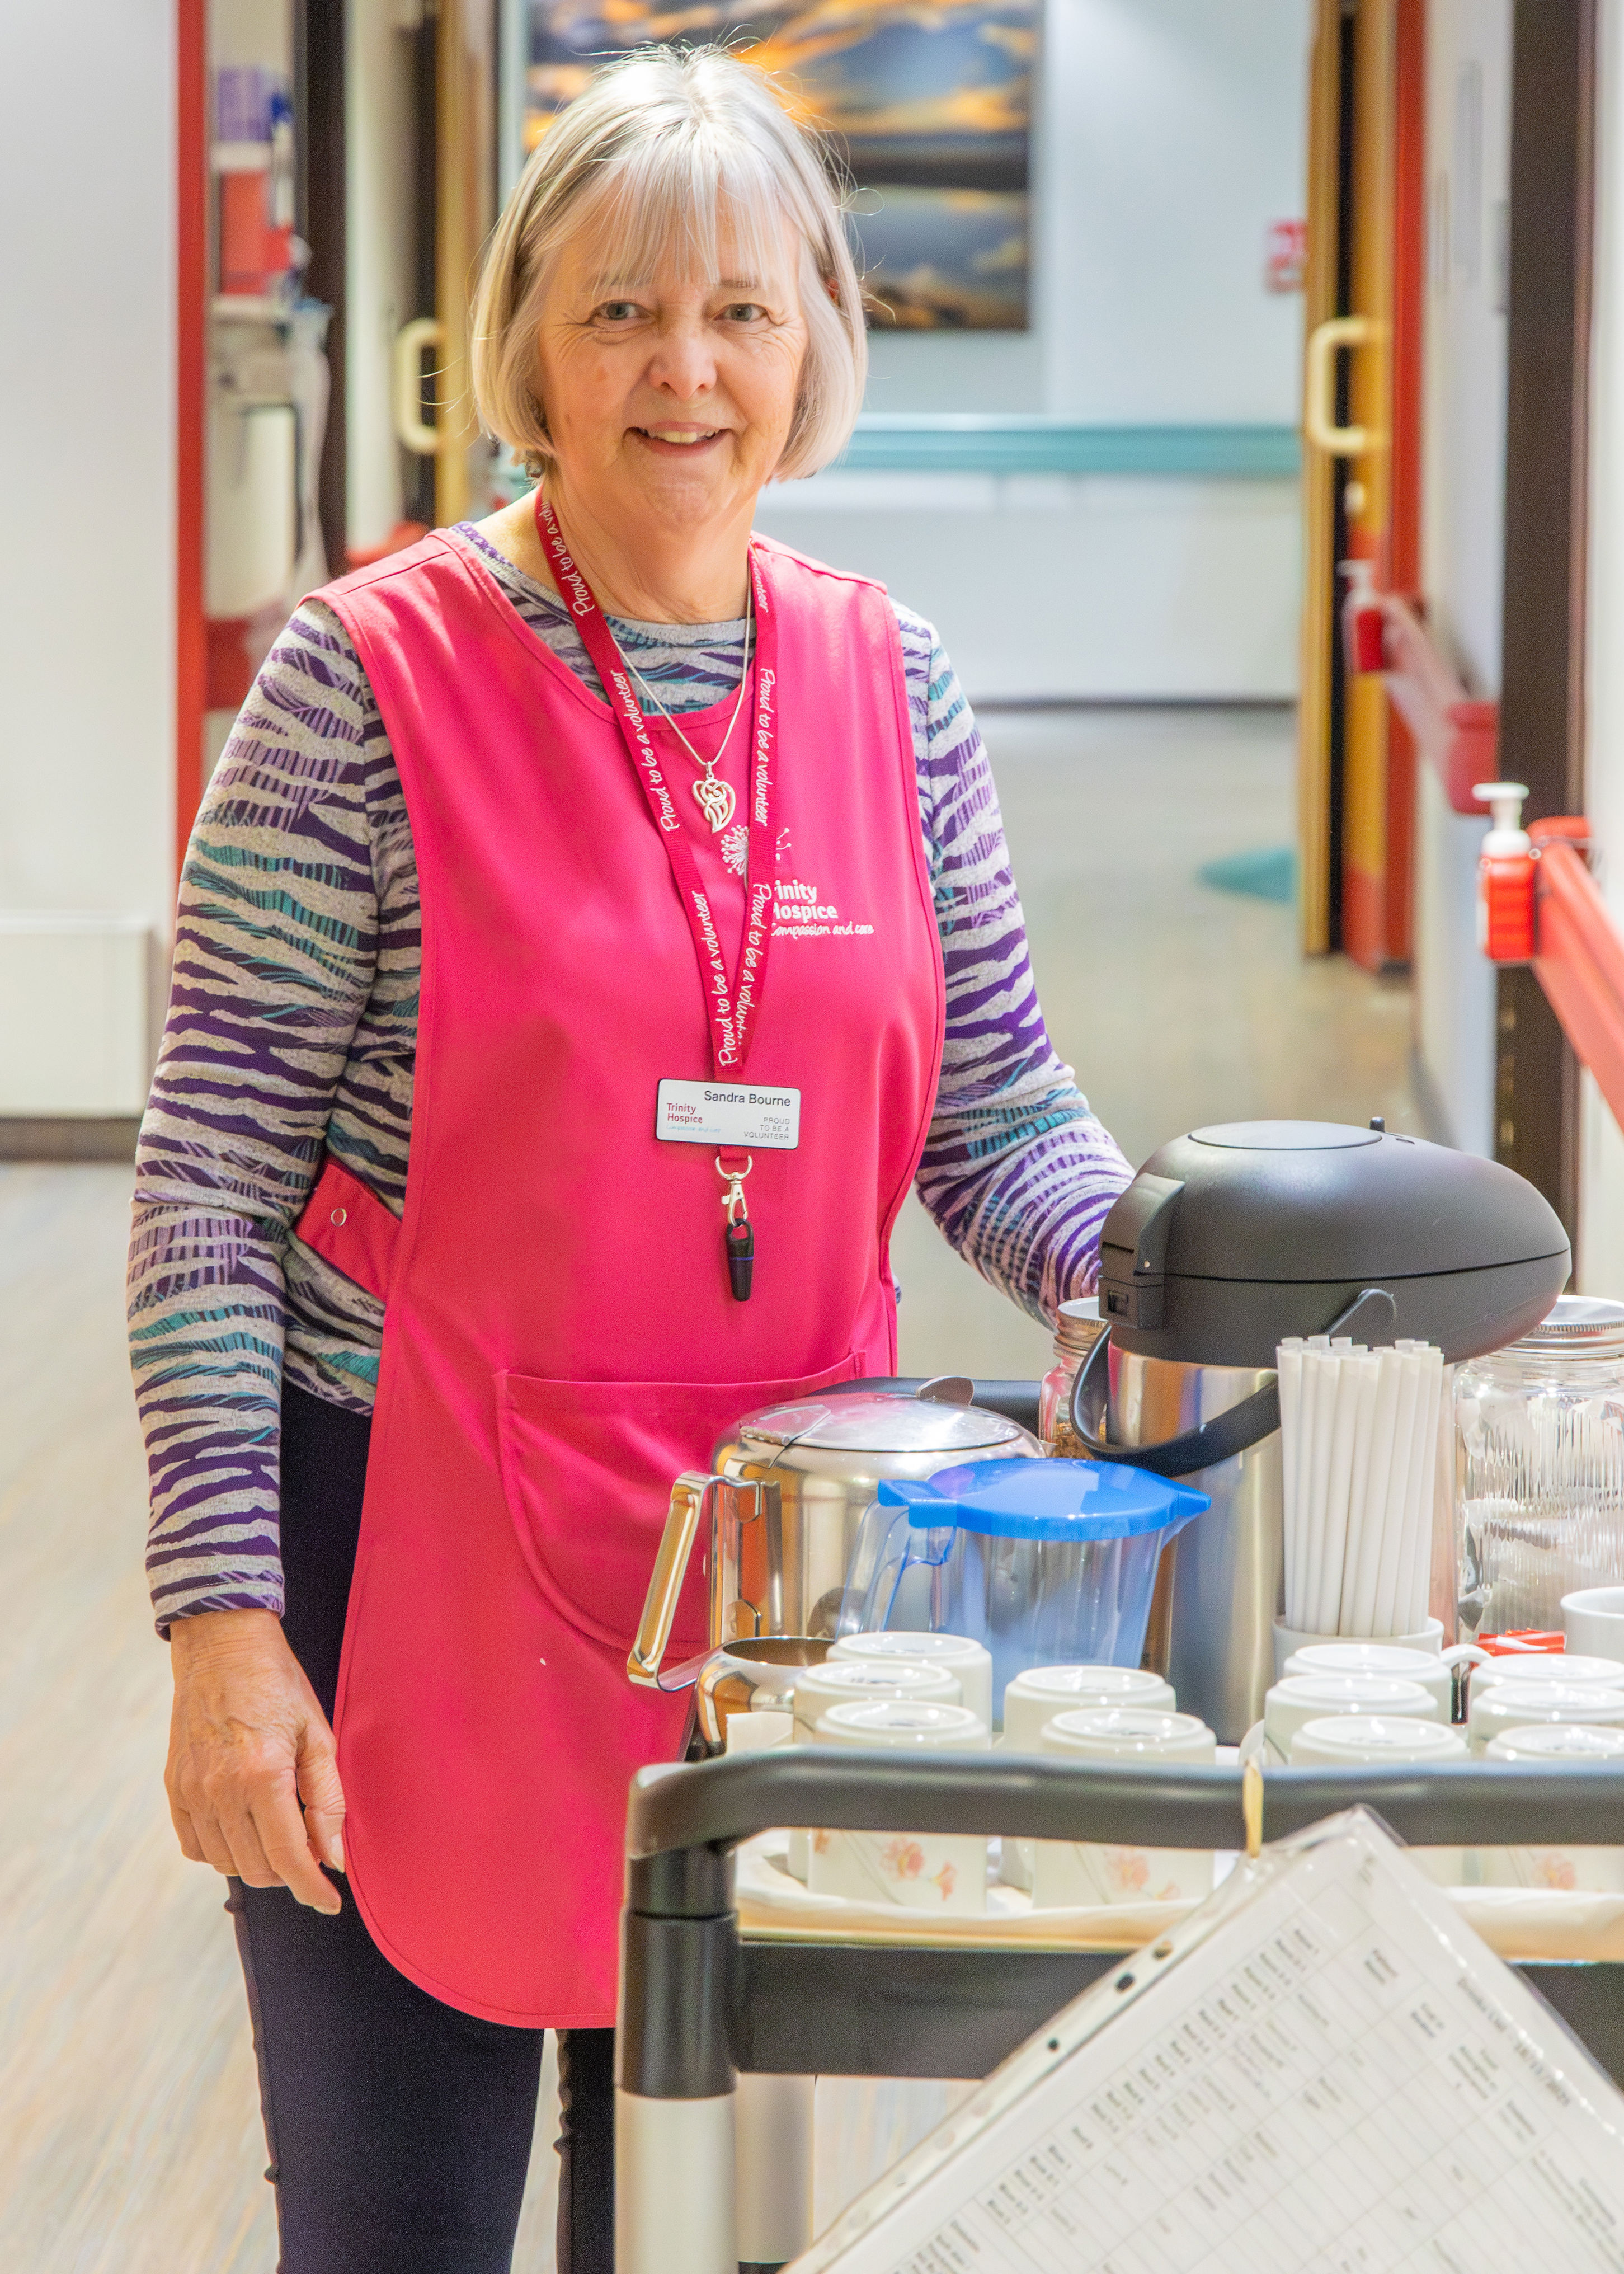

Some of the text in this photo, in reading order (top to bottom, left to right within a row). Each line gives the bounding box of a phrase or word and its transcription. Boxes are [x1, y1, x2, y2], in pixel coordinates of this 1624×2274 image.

[547, 523, 559, 534] a
[551, 537, 567, 558] be
[559, 557, 574, 571] to
[561, 570, 595, 617] Proud
[610, 669, 680, 833] Proud to be a volunteer
[755, 668, 776, 827] Proud to be a volunteer
[774, 879, 817, 905] inity
[750, 884, 773, 929] Proud
[832, 920, 855, 935] and
[748, 930, 763, 946] to
[745, 947, 764, 968] be
[691, 890, 738, 1066] Proud to be a volunteer
[742, 969, 755, 982] a
[704, 1090, 791, 1106] Sandra Bourne
[666, 1102, 696, 1115] Trinity
[667, 1113, 703, 1125] Hospice
[743, 1131, 789, 1140] VOLUNTEER
